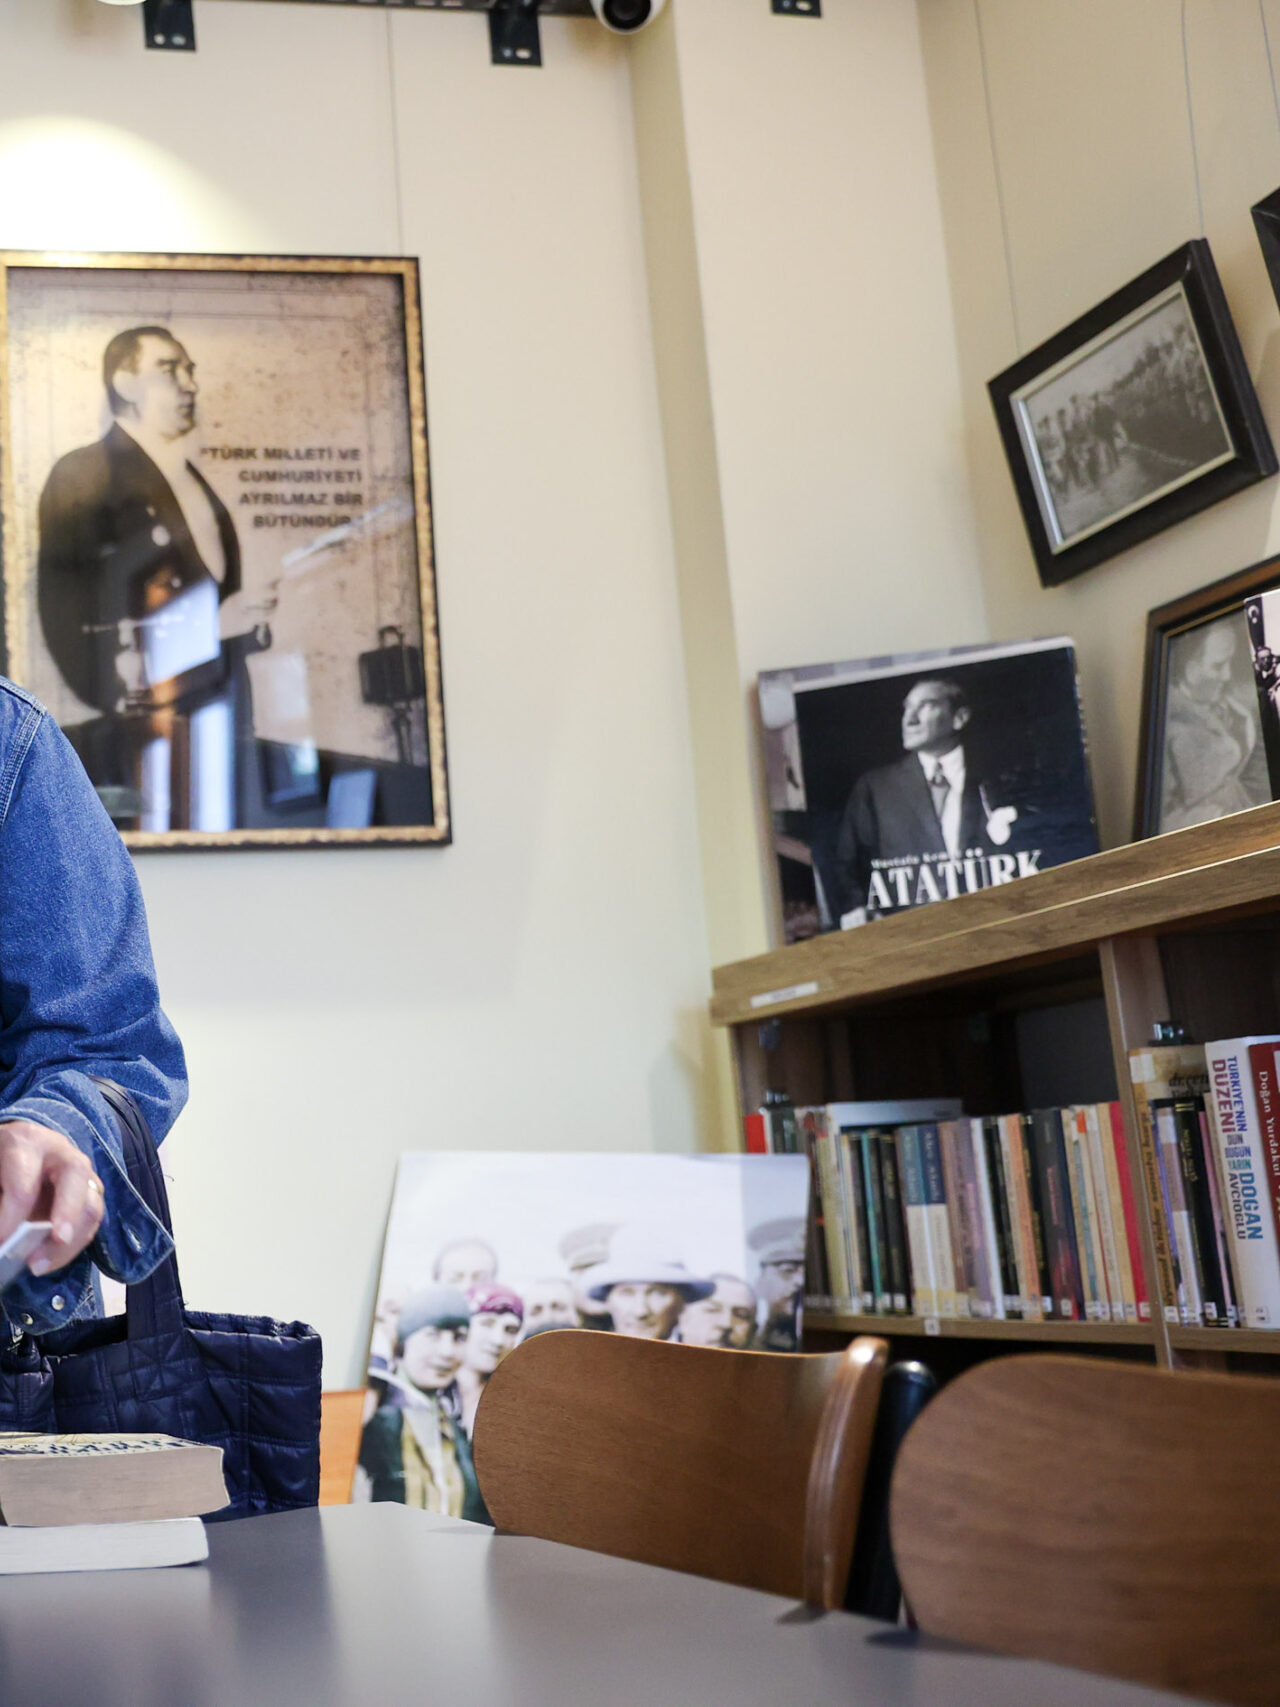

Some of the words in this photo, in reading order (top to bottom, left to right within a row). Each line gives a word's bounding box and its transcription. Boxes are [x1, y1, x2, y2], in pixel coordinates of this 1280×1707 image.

[338, 448, 361, 460] VE
[238, 469, 363, 483] CUMHURİYETİ
[239, 492, 328, 505] AYRILMAZ
[334, 491, 363, 505] BİR
[866, 847, 1043, 911] ATATÜRK
[1259, 1071, 1272, 1113] Doğan
